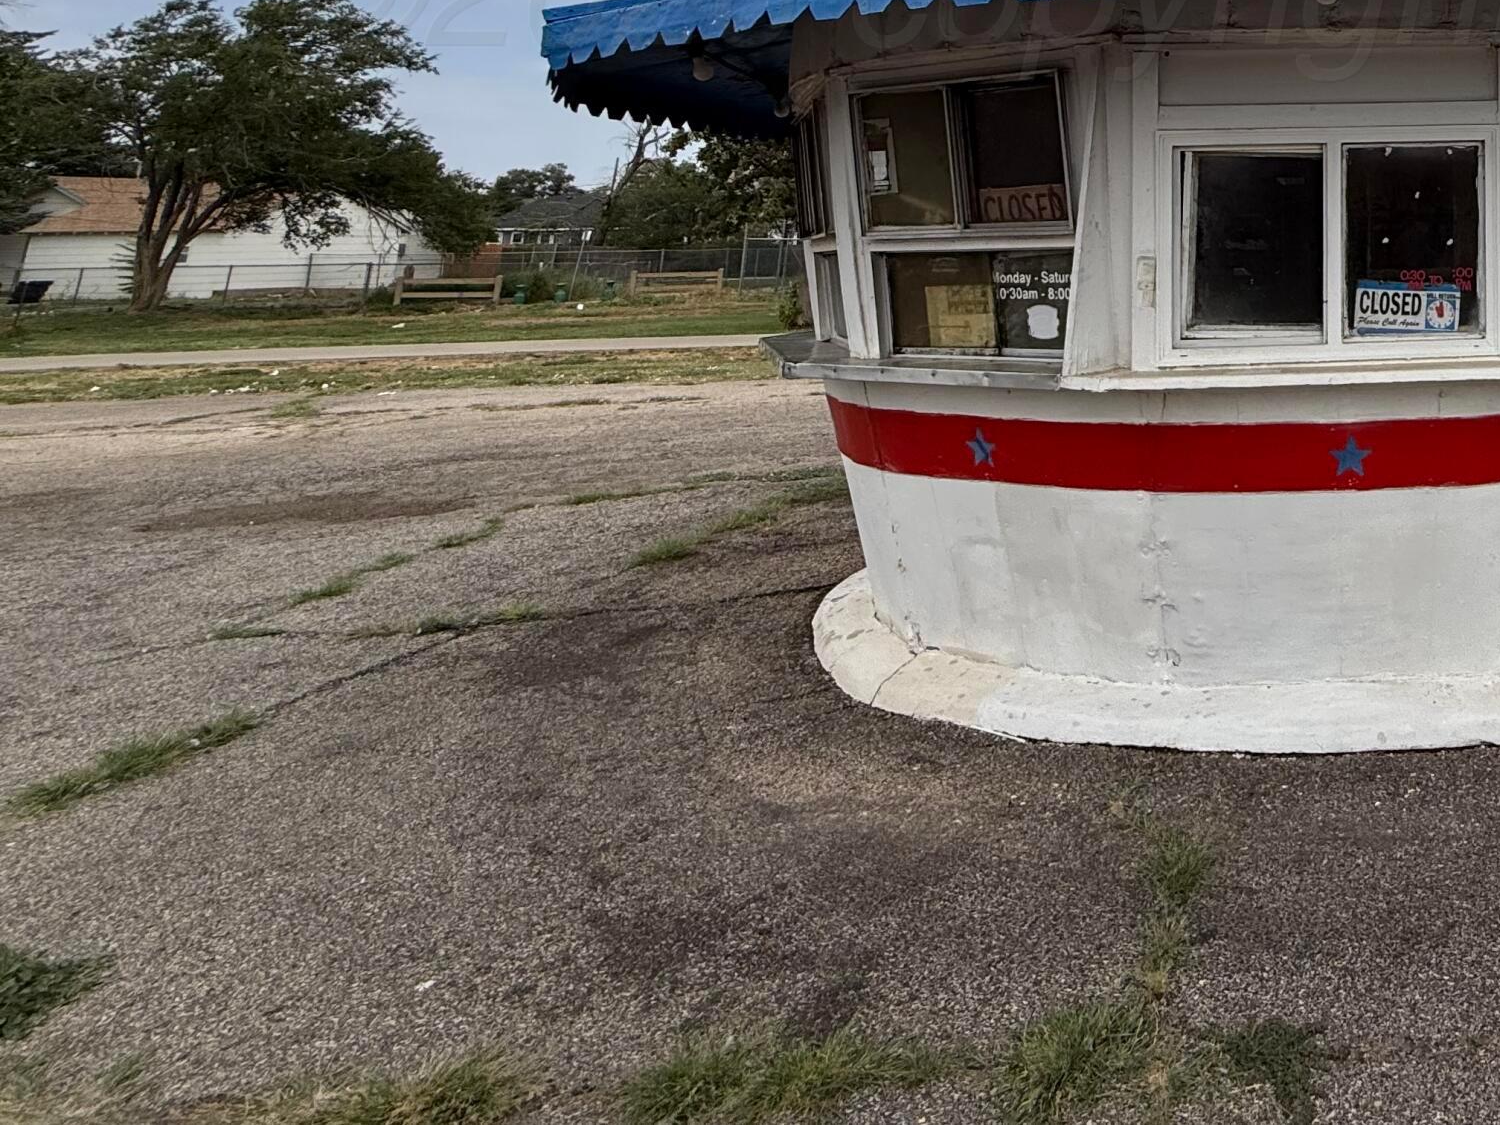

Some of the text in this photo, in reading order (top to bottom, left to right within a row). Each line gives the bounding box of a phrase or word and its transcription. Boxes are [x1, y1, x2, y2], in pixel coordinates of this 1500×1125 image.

[1360, 290, 1422, 316] CLOSED
[1357, 316, 1380, 326] Please
[1398, 318, 1420, 329] Again
